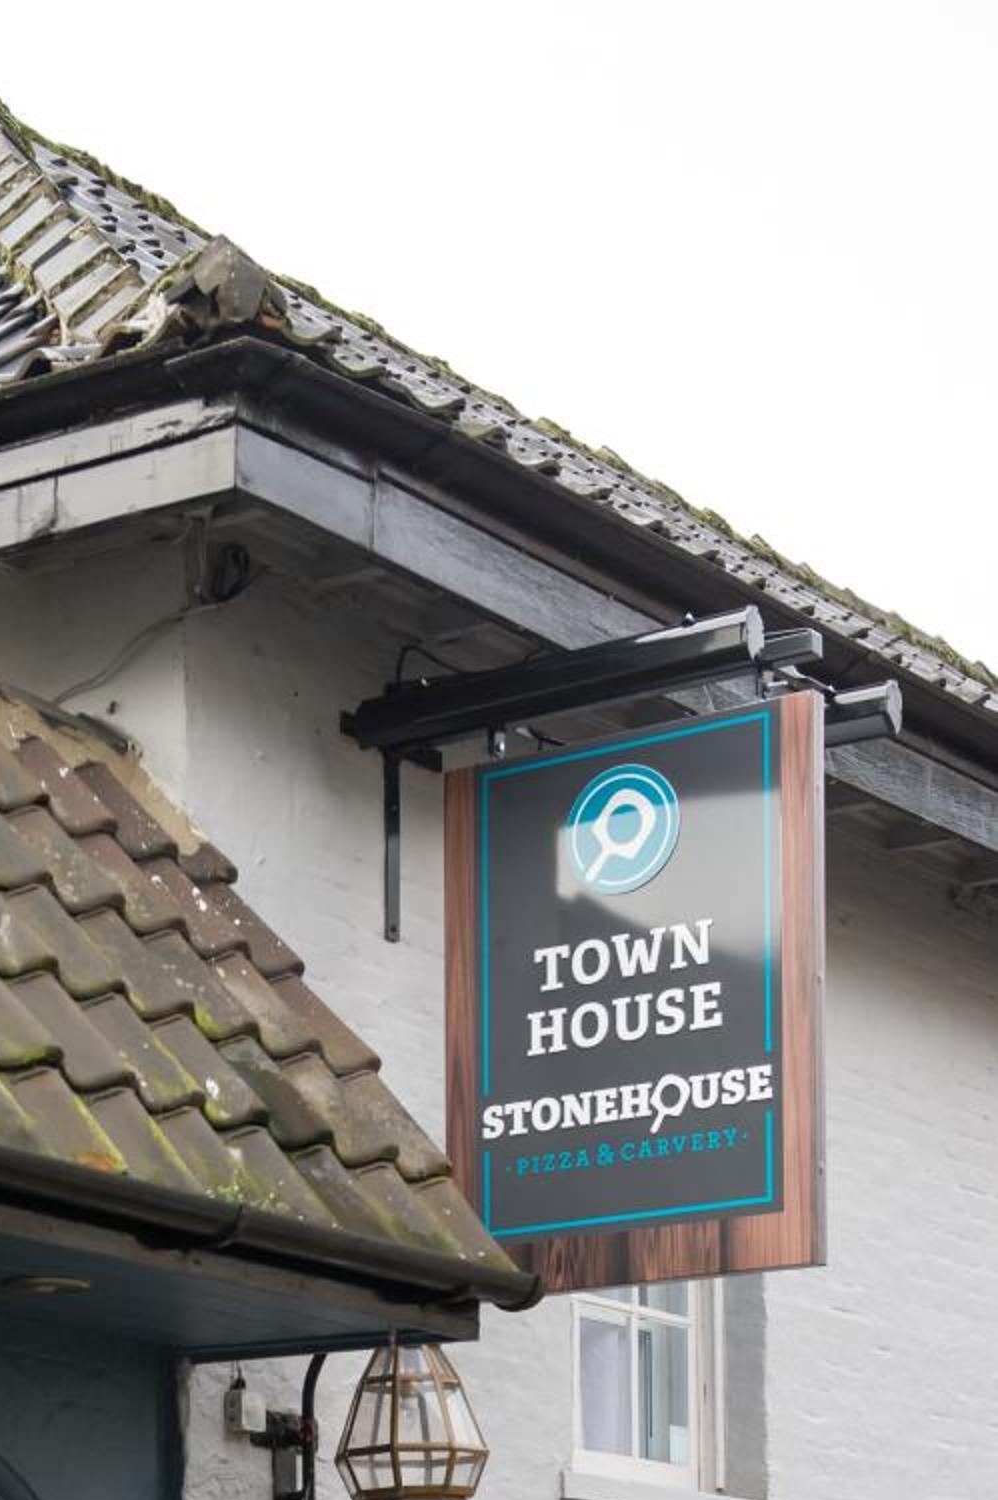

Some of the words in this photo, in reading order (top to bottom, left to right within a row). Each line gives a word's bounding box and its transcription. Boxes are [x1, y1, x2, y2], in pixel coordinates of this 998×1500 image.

[534, 917, 713, 992] TOWN
[526, 981, 723, 1057] HOUSE
[481, 1064, 773, 1139] STONEHOUSE
[516, 1149, 590, 1177] PIZZA
[596, 1143, 615, 1166] &
[621, 1127, 738, 1161] CARVERY
